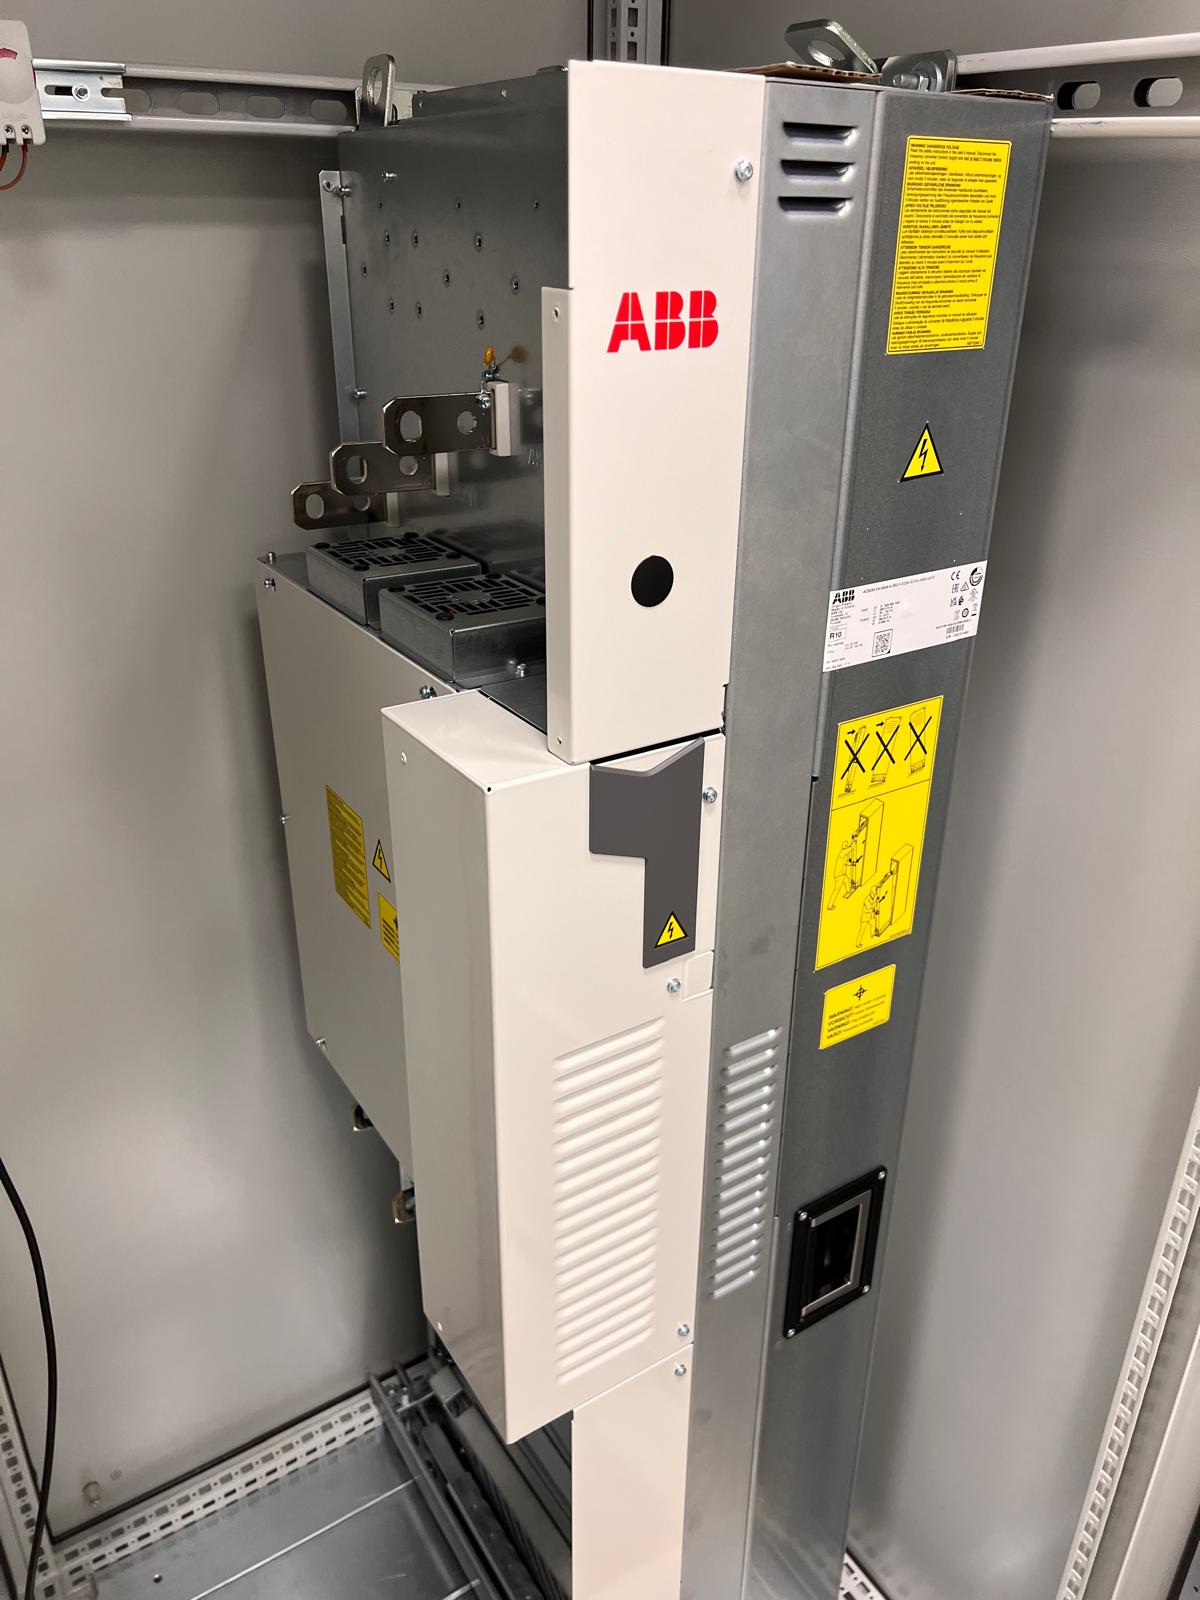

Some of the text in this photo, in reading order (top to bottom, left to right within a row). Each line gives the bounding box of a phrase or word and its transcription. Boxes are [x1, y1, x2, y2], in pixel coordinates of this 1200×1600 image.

[607, 290, 719, 353] ABB
[832, 589, 855, 605] ABB
[829, 631, 842, 640] R10
